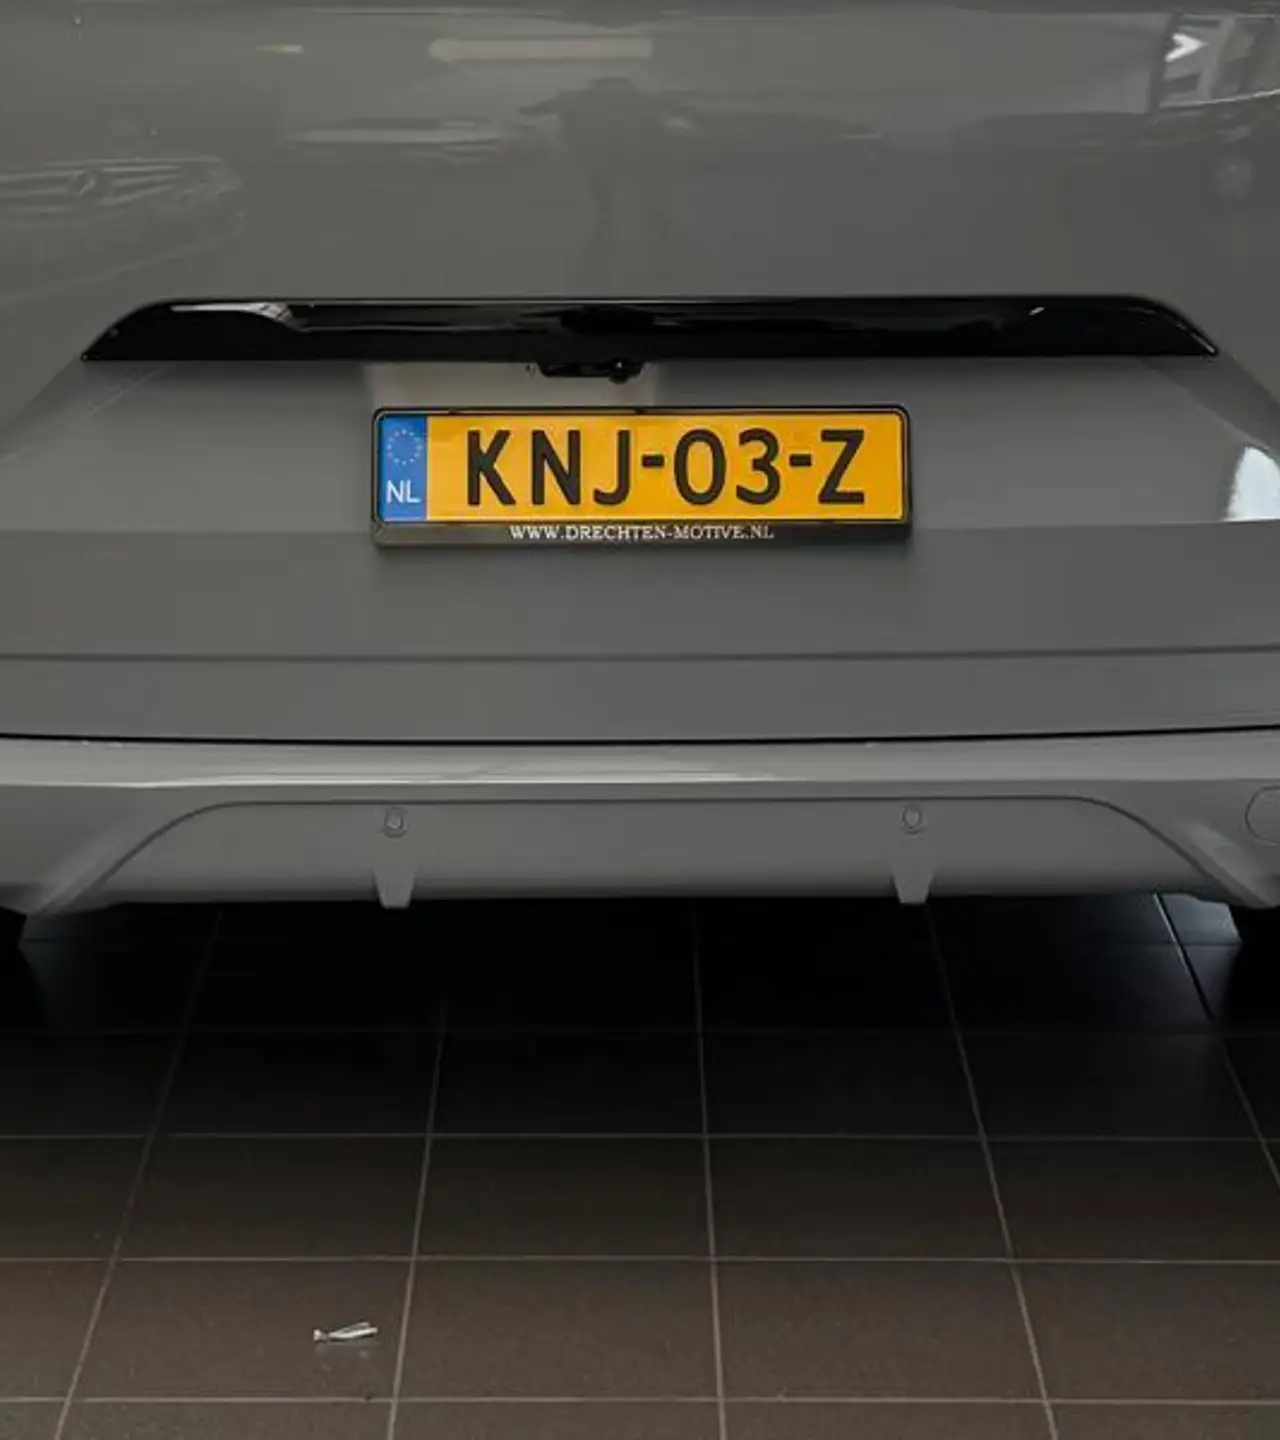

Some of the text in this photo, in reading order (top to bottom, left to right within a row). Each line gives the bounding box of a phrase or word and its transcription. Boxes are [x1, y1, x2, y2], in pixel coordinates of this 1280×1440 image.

[465, 428, 866, 506] KNJ-03-Z
[386, 479, 421, 504] NL
[508, 523, 775, 541] WWW.DRECHTEN-MOTIVE.NL
